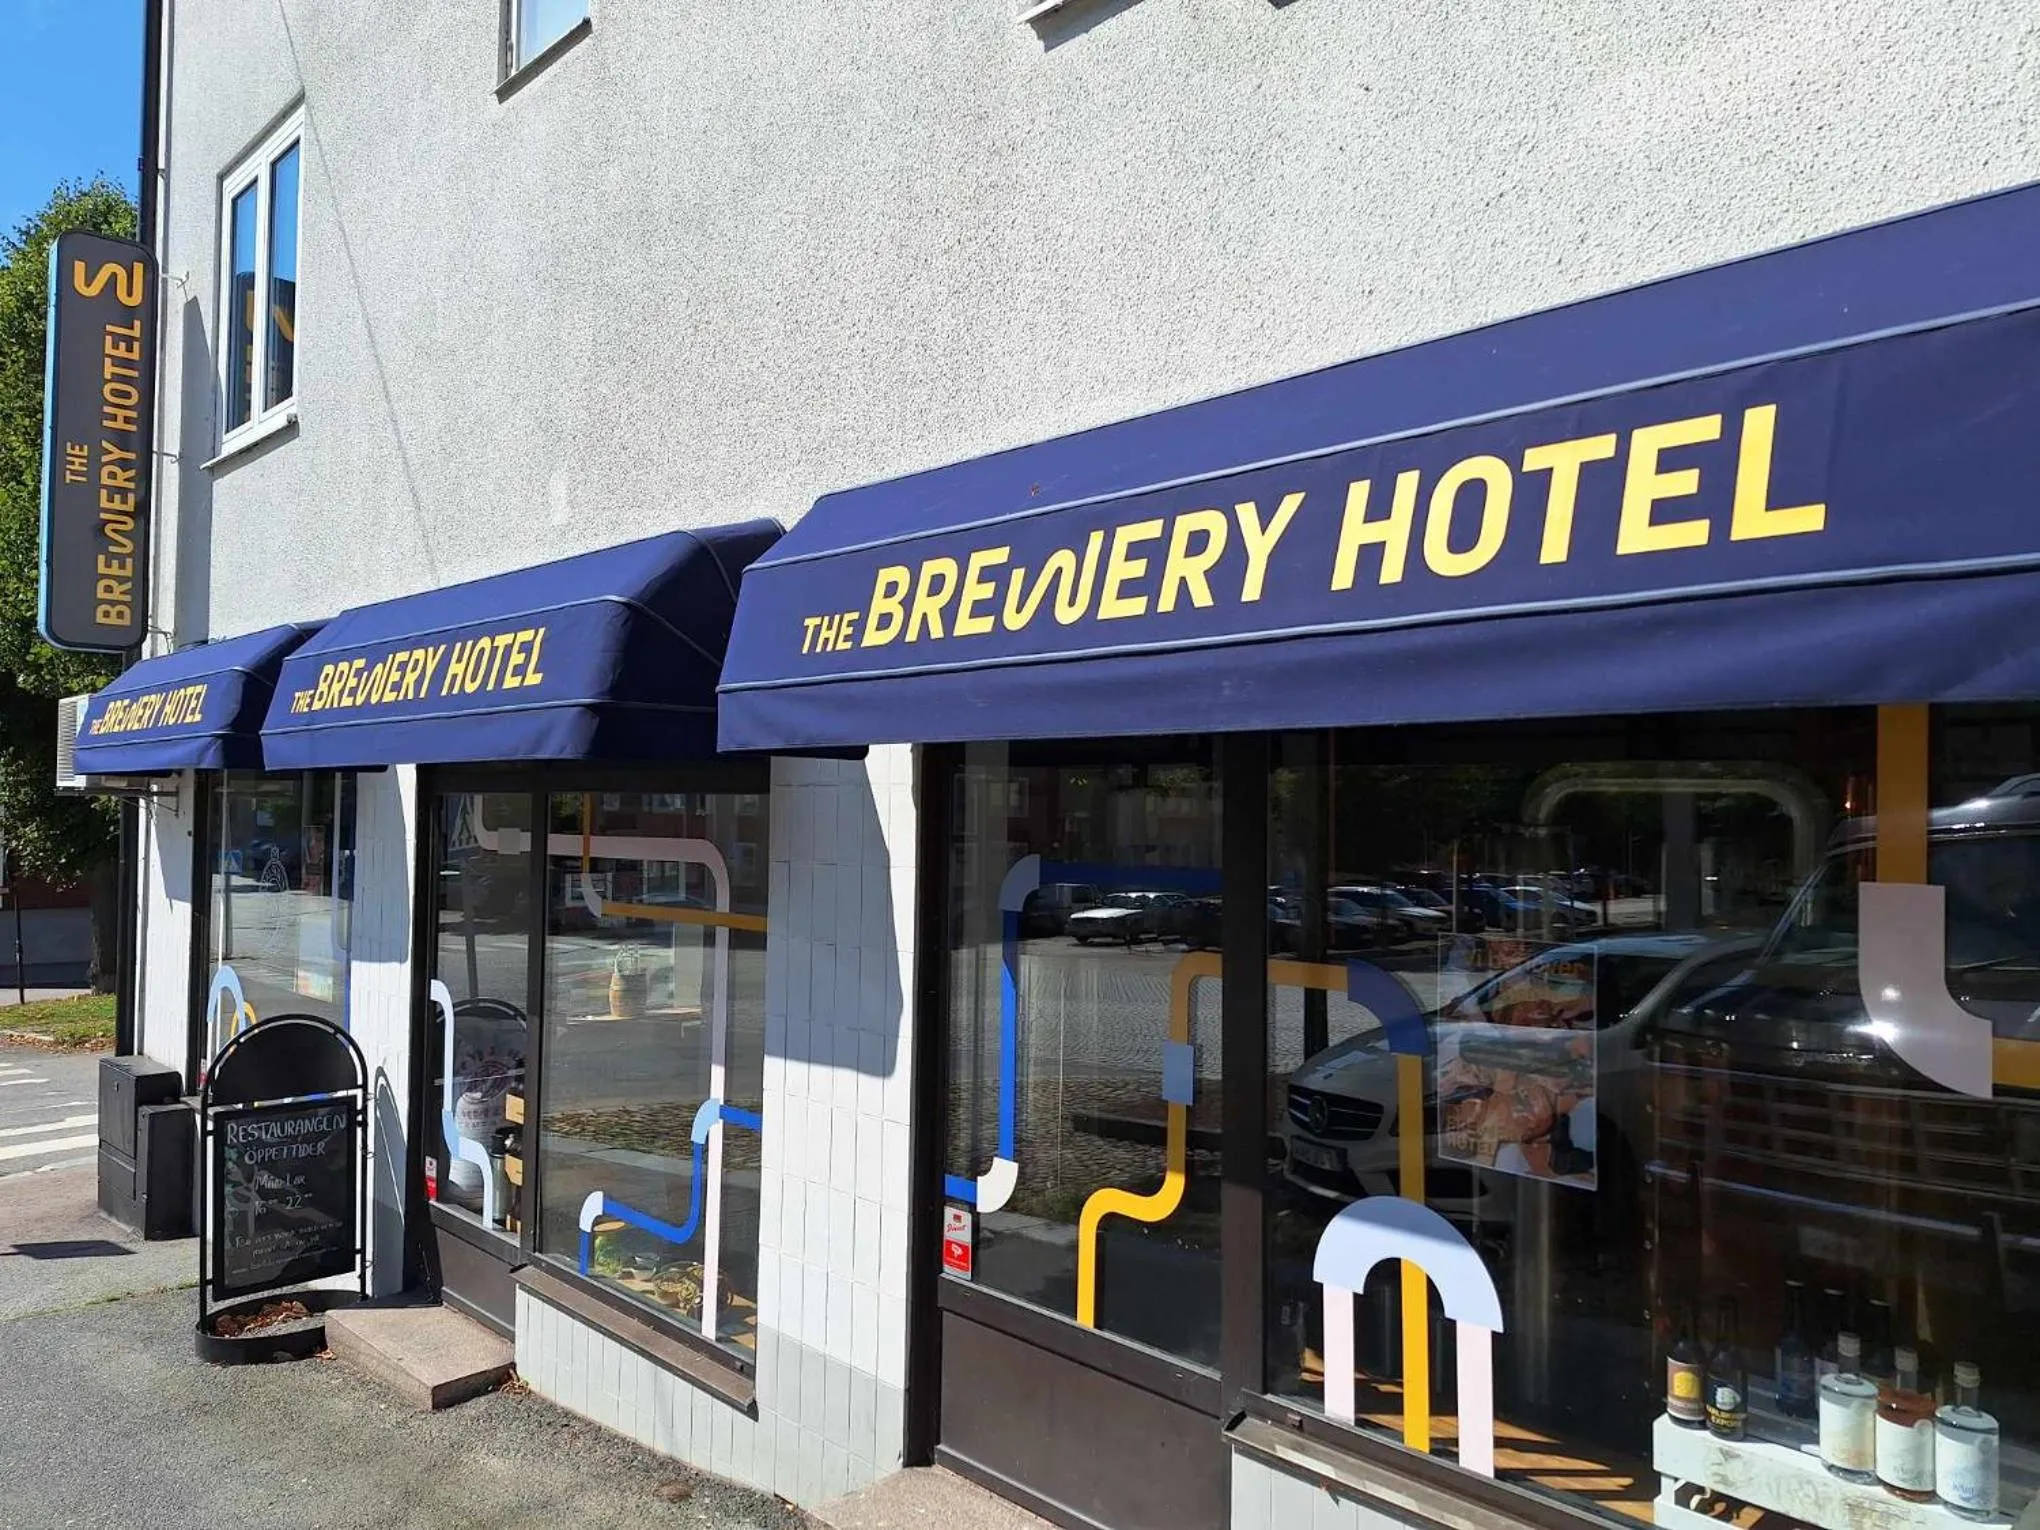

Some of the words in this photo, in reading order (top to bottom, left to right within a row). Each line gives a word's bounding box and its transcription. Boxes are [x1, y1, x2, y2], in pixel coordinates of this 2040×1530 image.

[102, 319, 142, 433] HOTEL
[65, 441, 89, 484] THE
[95, 439, 138, 627] BREWERY
[801, 611, 860, 655] THE
[860, 491, 1306, 648] BREWERY
[1330, 403, 1827, 592] HOTEL
[89, 718, 102, 735] THE
[100, 692, 162, 734] BREWERY
[159, 684, 208, 728] HOTEL
[291, 689, 315, 714] THE
[312, 644, 447, 711] BREWERY
[441, 627, 547, 696] HOTEL
[226, 1113, 347, 1145] RESTAURANGEN
